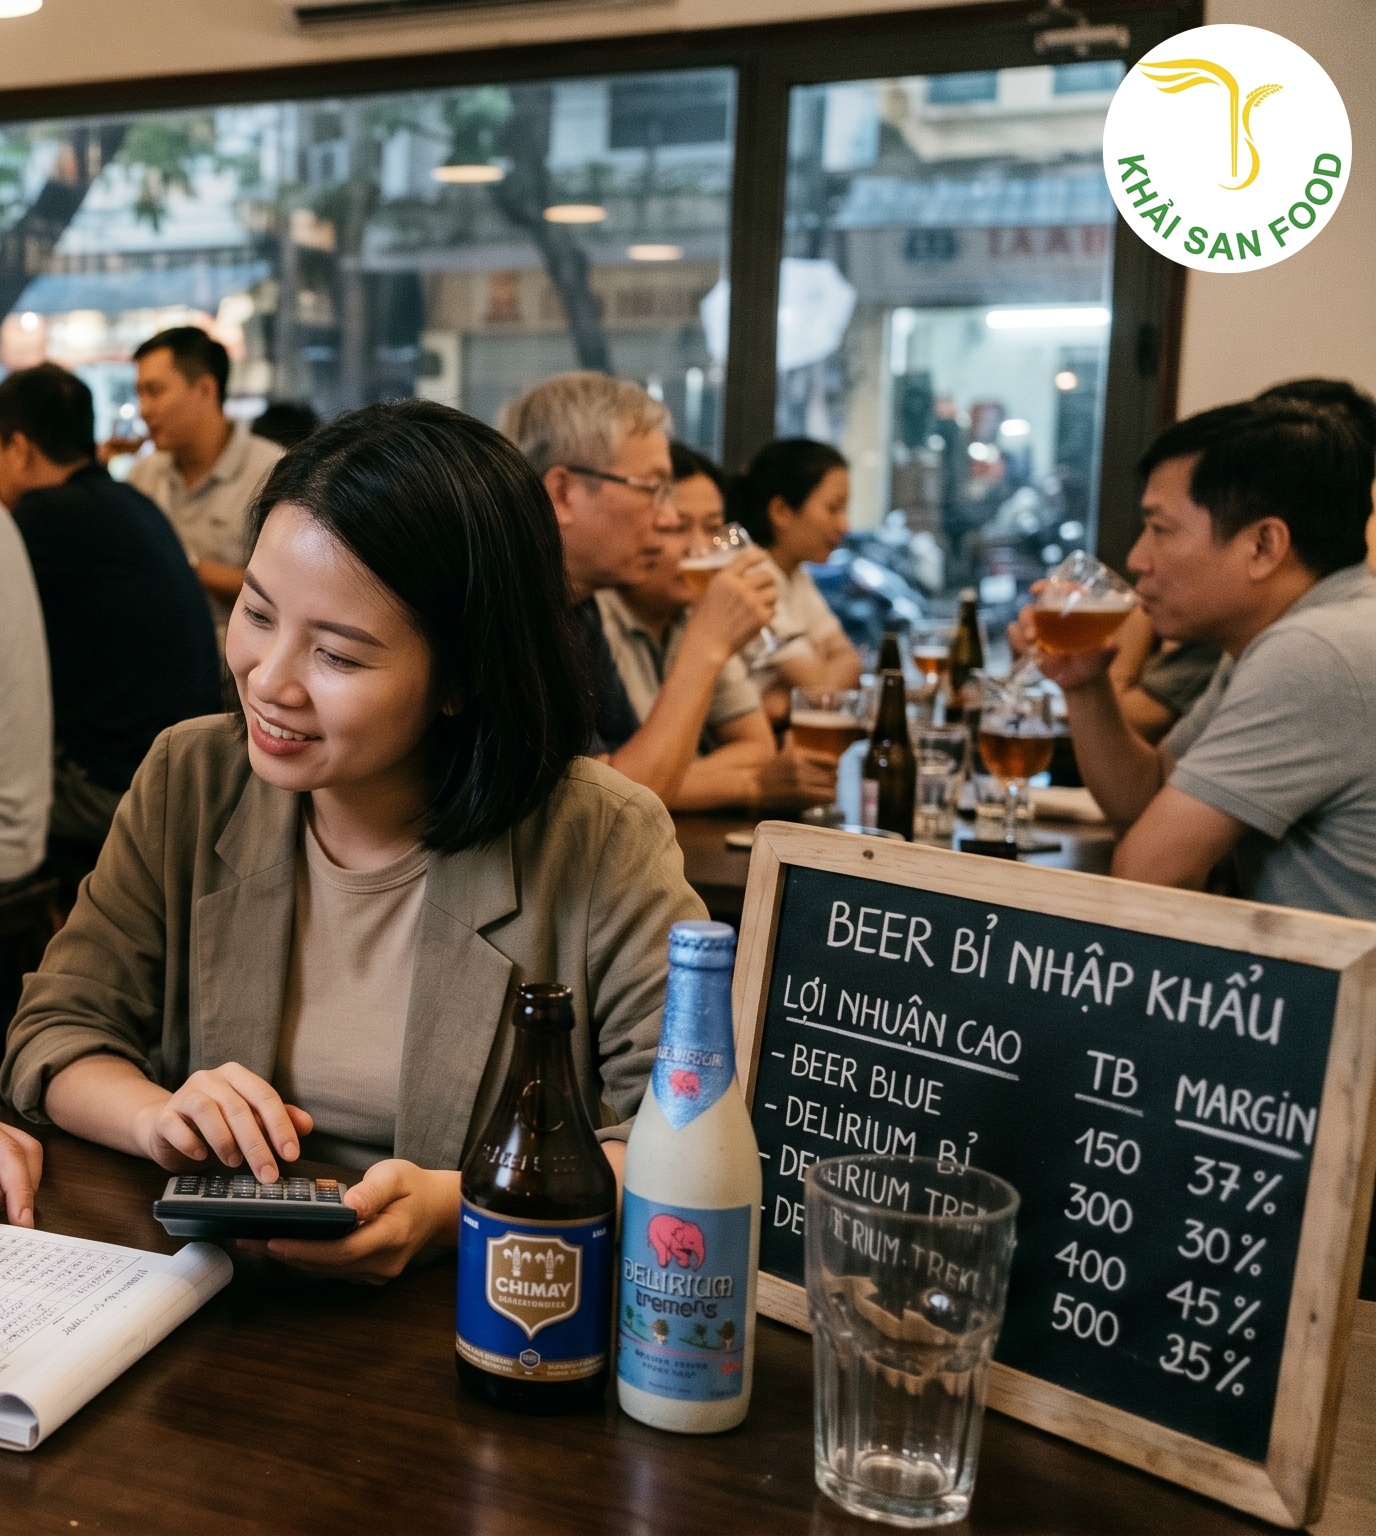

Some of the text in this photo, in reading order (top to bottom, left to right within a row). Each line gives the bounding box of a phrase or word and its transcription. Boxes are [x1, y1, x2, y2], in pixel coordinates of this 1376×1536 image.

[826, 900, 934, 968] BEER
[1007, 940, 1135, 1013] NHẬP
[1145, 963, 1285, 1046] KHẨU
[783, 974, 1022, 1065] LỢI NHUẬN CAO
[791, 1043, 858, 1093] BEER
[869, 1065, 945, 1116] BLUE
[1086, 1049, 1139, 1098] TB
[1075, 1127, 1141, 1175] 150
[1064, 1182, 1133, 1234] 300
[494, 1276, 572, 1298] CHIMAY
[623, 1257, 734, 1299] DELIRIUM
[1054, 1240, 1126, 1291] 400
[635, 1288, 718, 1319] tremens
[1051, 1292, 1119, 1347] 500
